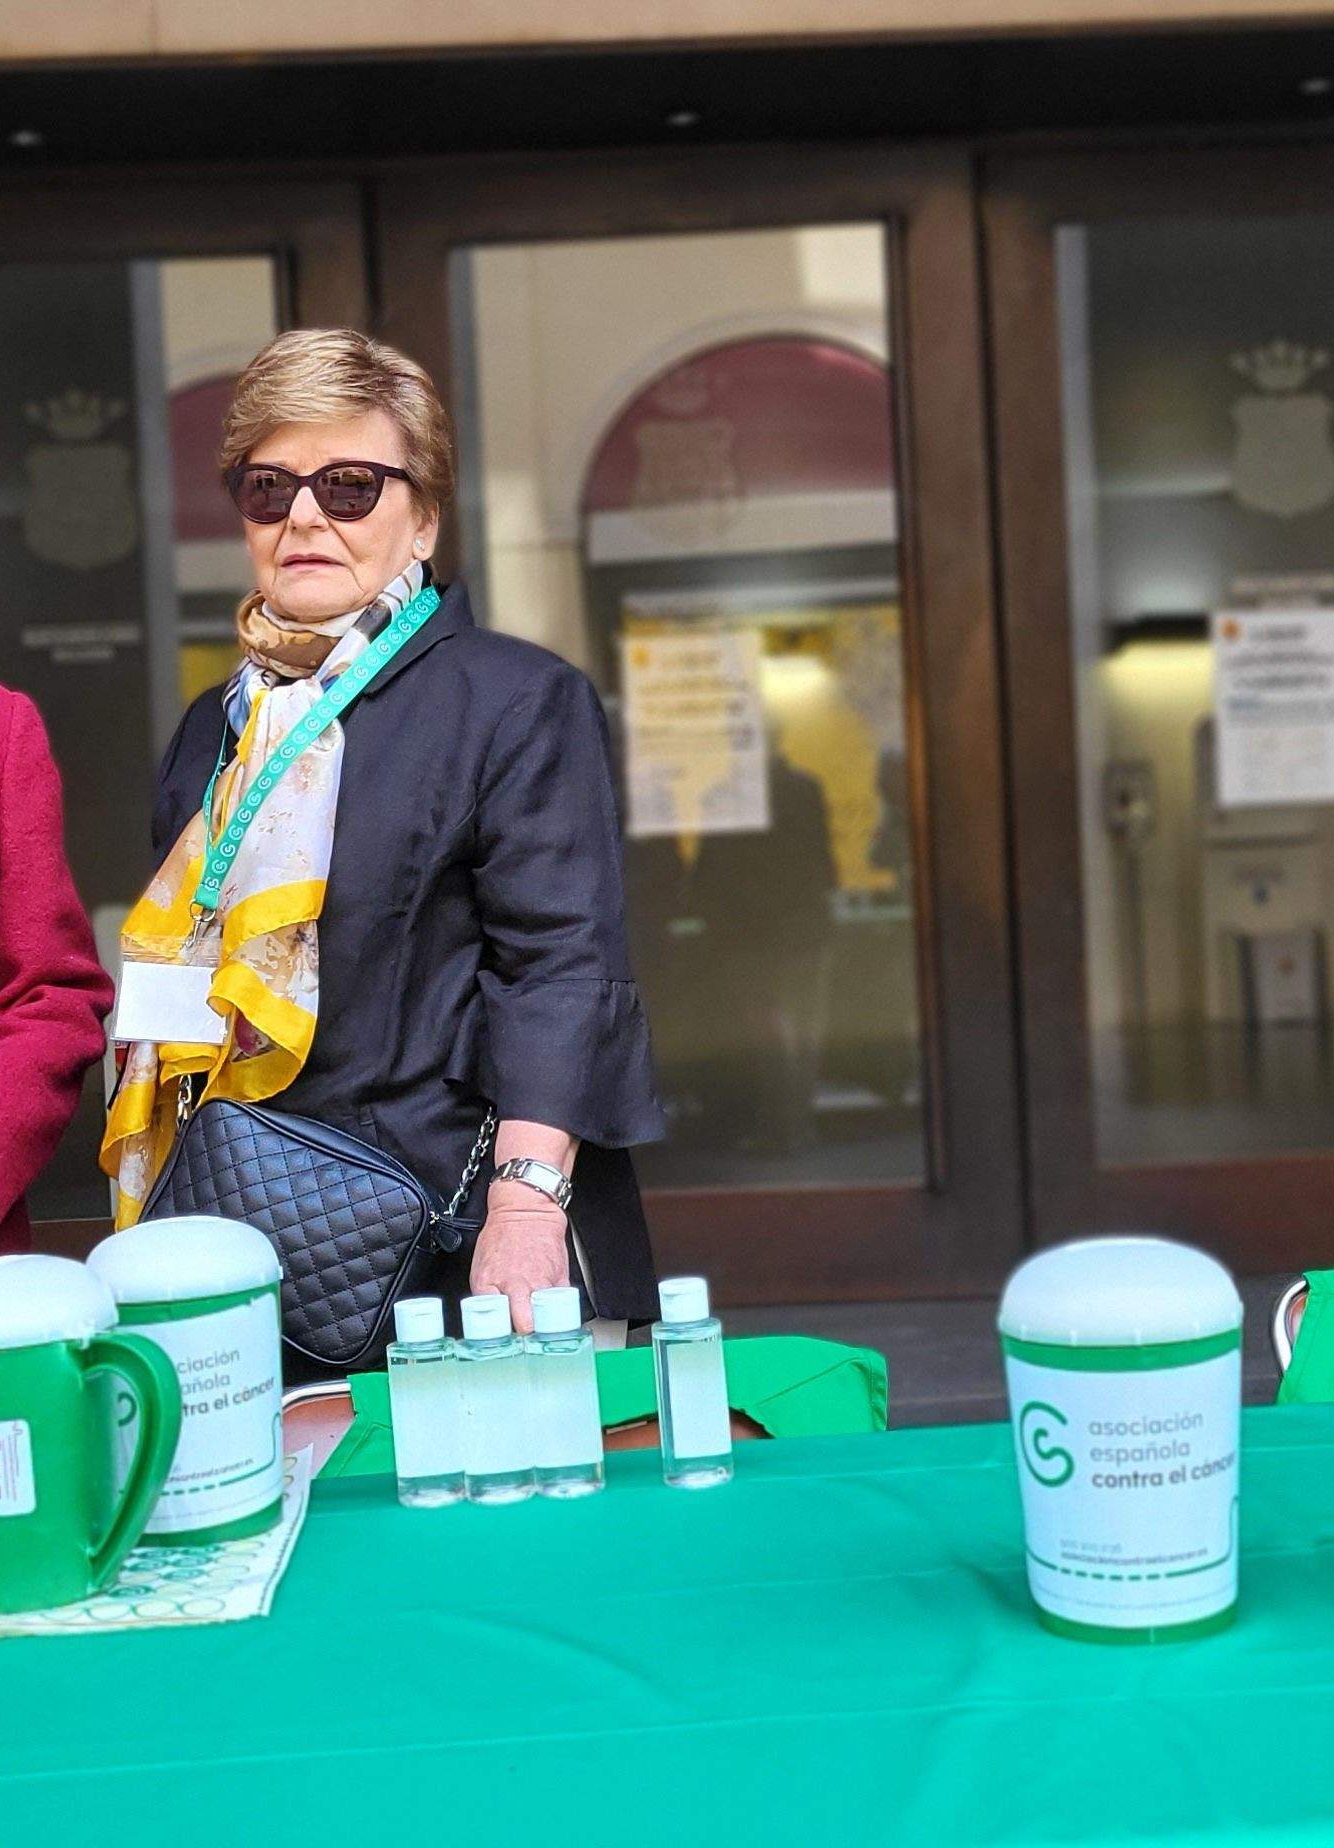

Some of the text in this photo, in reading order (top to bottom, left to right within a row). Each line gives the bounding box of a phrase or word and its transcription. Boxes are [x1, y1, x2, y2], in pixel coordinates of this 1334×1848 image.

[176, 1347, 240, 1375] ciación
[181, 1373, 230, 1396] añola
[182, 1402, 209, 1417] tra
[213, 1392, 229, 1410] el
[1087, 1410, 1204, 1436] asociación
[1089, 1438, 1191, 1467] española
[1091, 1470, 1164, 1489] contra
[1168, 1464, 1187, 1485] el
